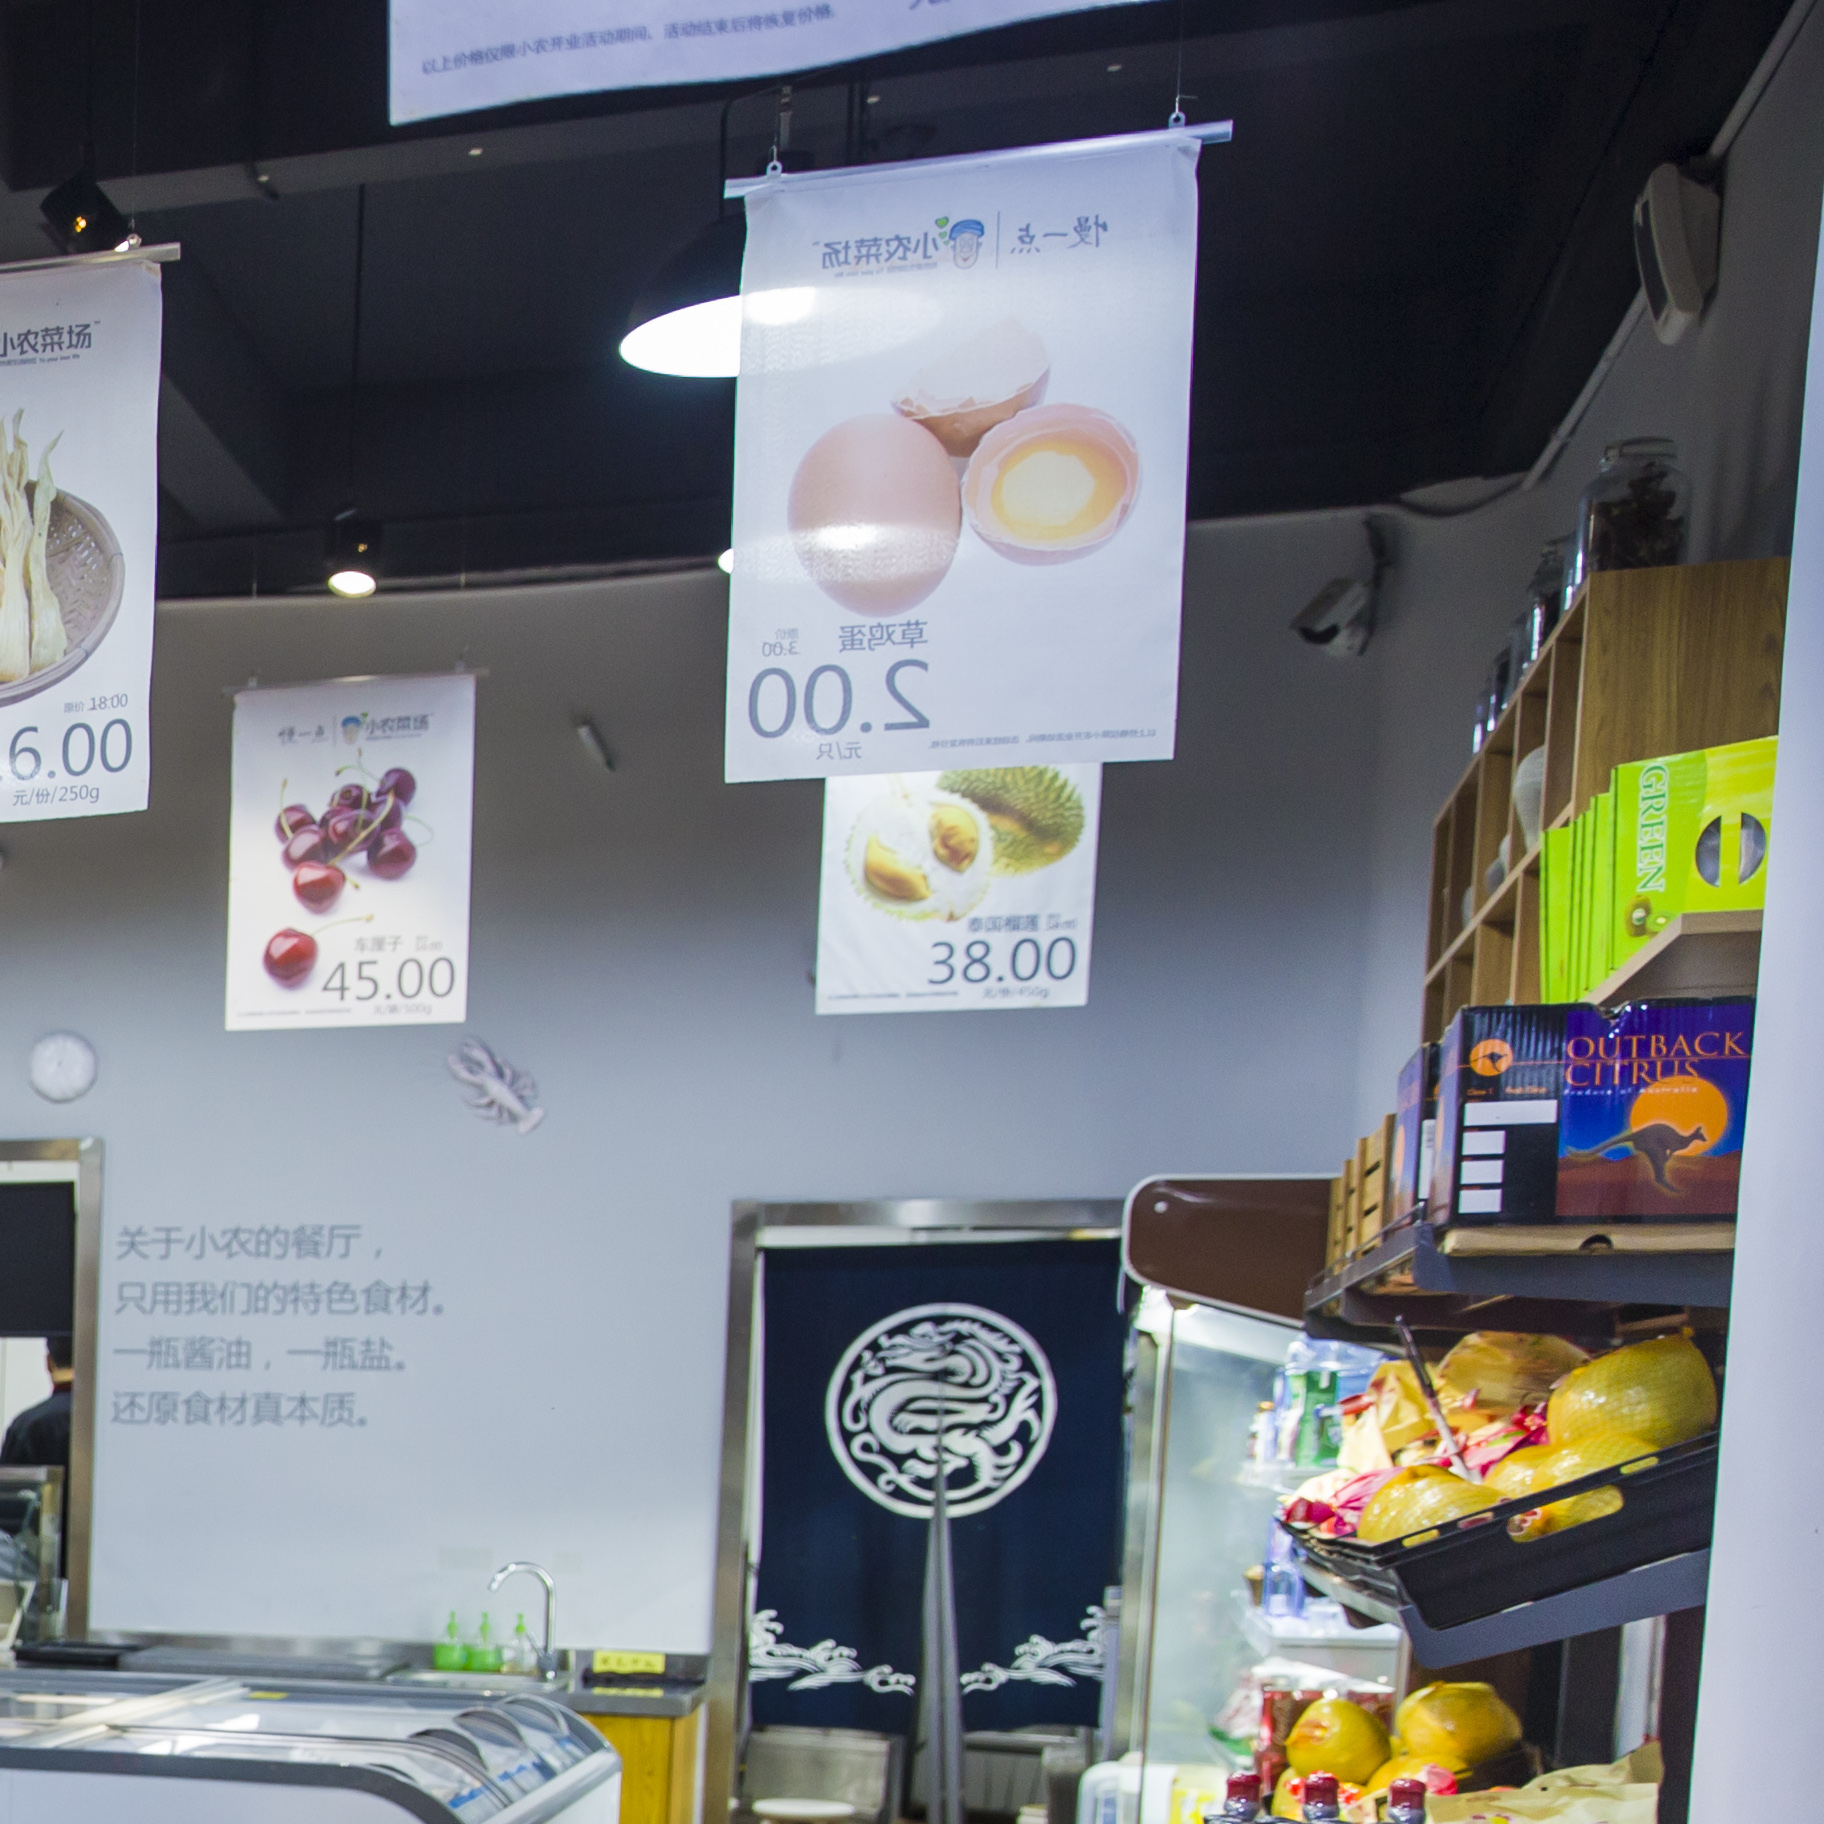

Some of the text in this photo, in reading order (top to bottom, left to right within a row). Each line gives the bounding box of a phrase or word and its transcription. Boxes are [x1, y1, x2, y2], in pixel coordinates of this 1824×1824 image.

[88, 693, 129, 712] 18.00
[12, 784, 101, 807] 元/份/250g
[1635, 765, 1670, 893] GREEN
[928, 936, 1077, 985] 38.00
[321, 956, 456, 1002] 45.00
[1566, 1030, 1746, 1060] OUTBACK
[1564, 1060, 1700, 1087] CITRUS
